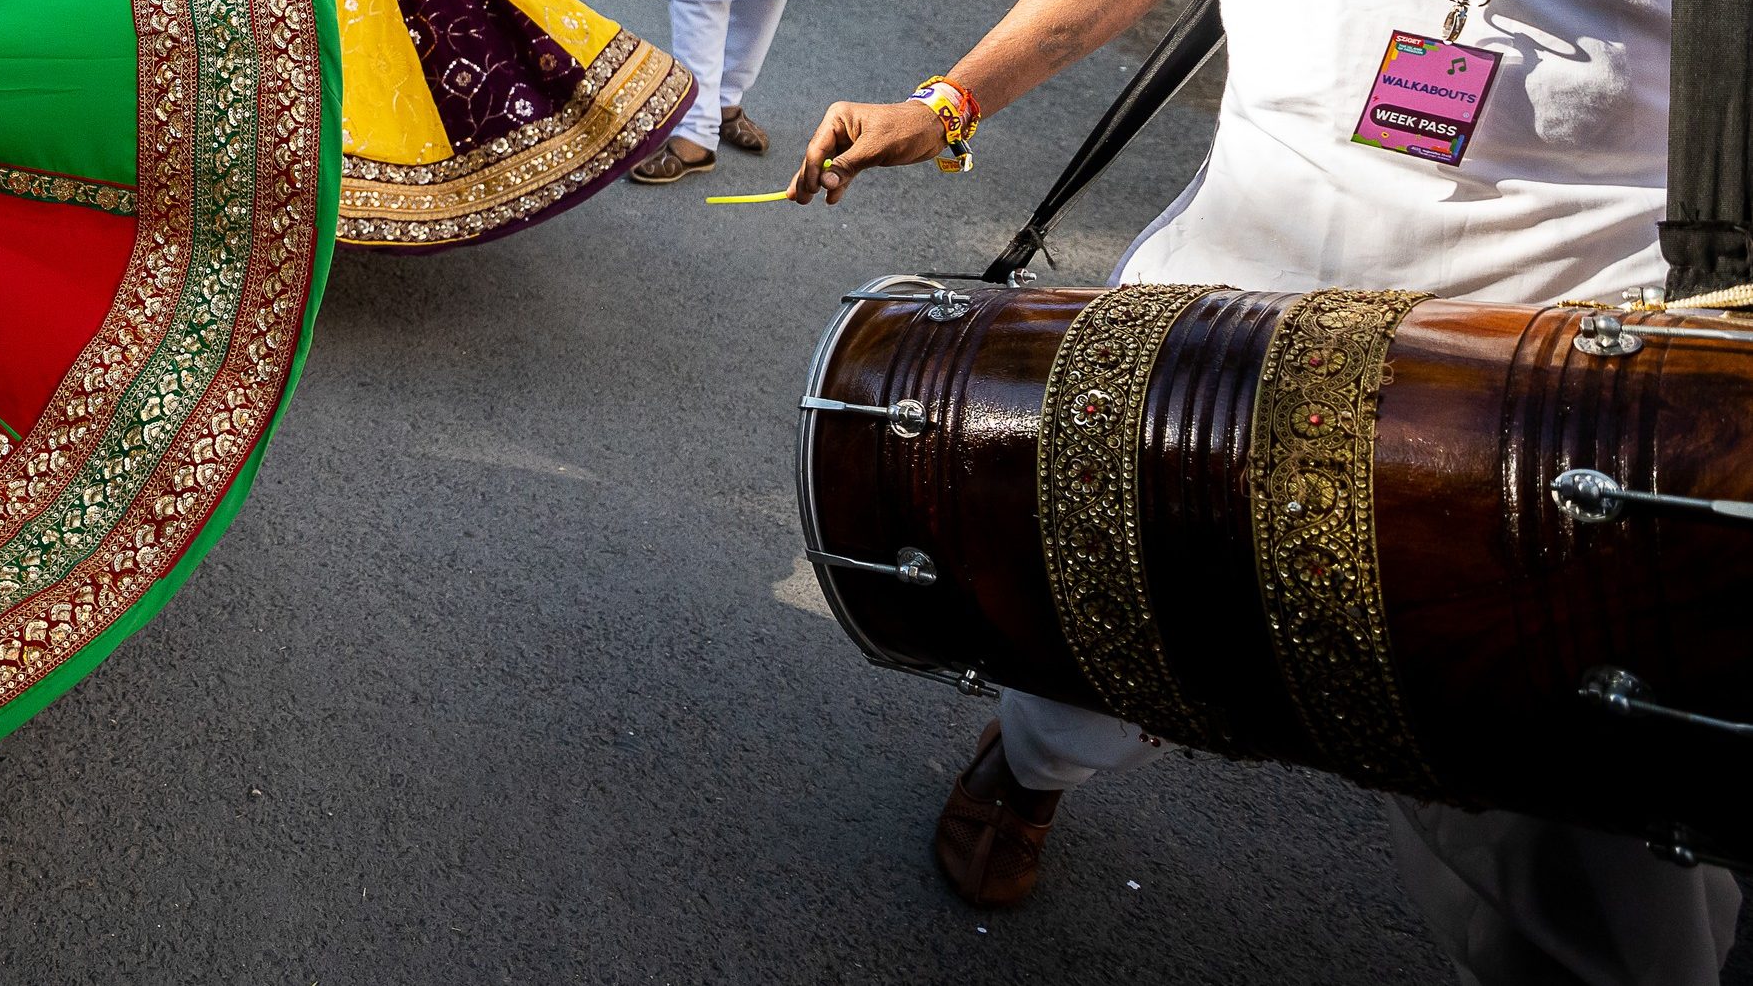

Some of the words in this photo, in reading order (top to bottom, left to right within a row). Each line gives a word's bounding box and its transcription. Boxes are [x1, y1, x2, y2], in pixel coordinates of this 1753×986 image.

[1382, 74, 1477, 104] WALKABOUTS
[1376, 108, 1417, 128] WEEK
[1418, 118, 1458, 137] PASS
